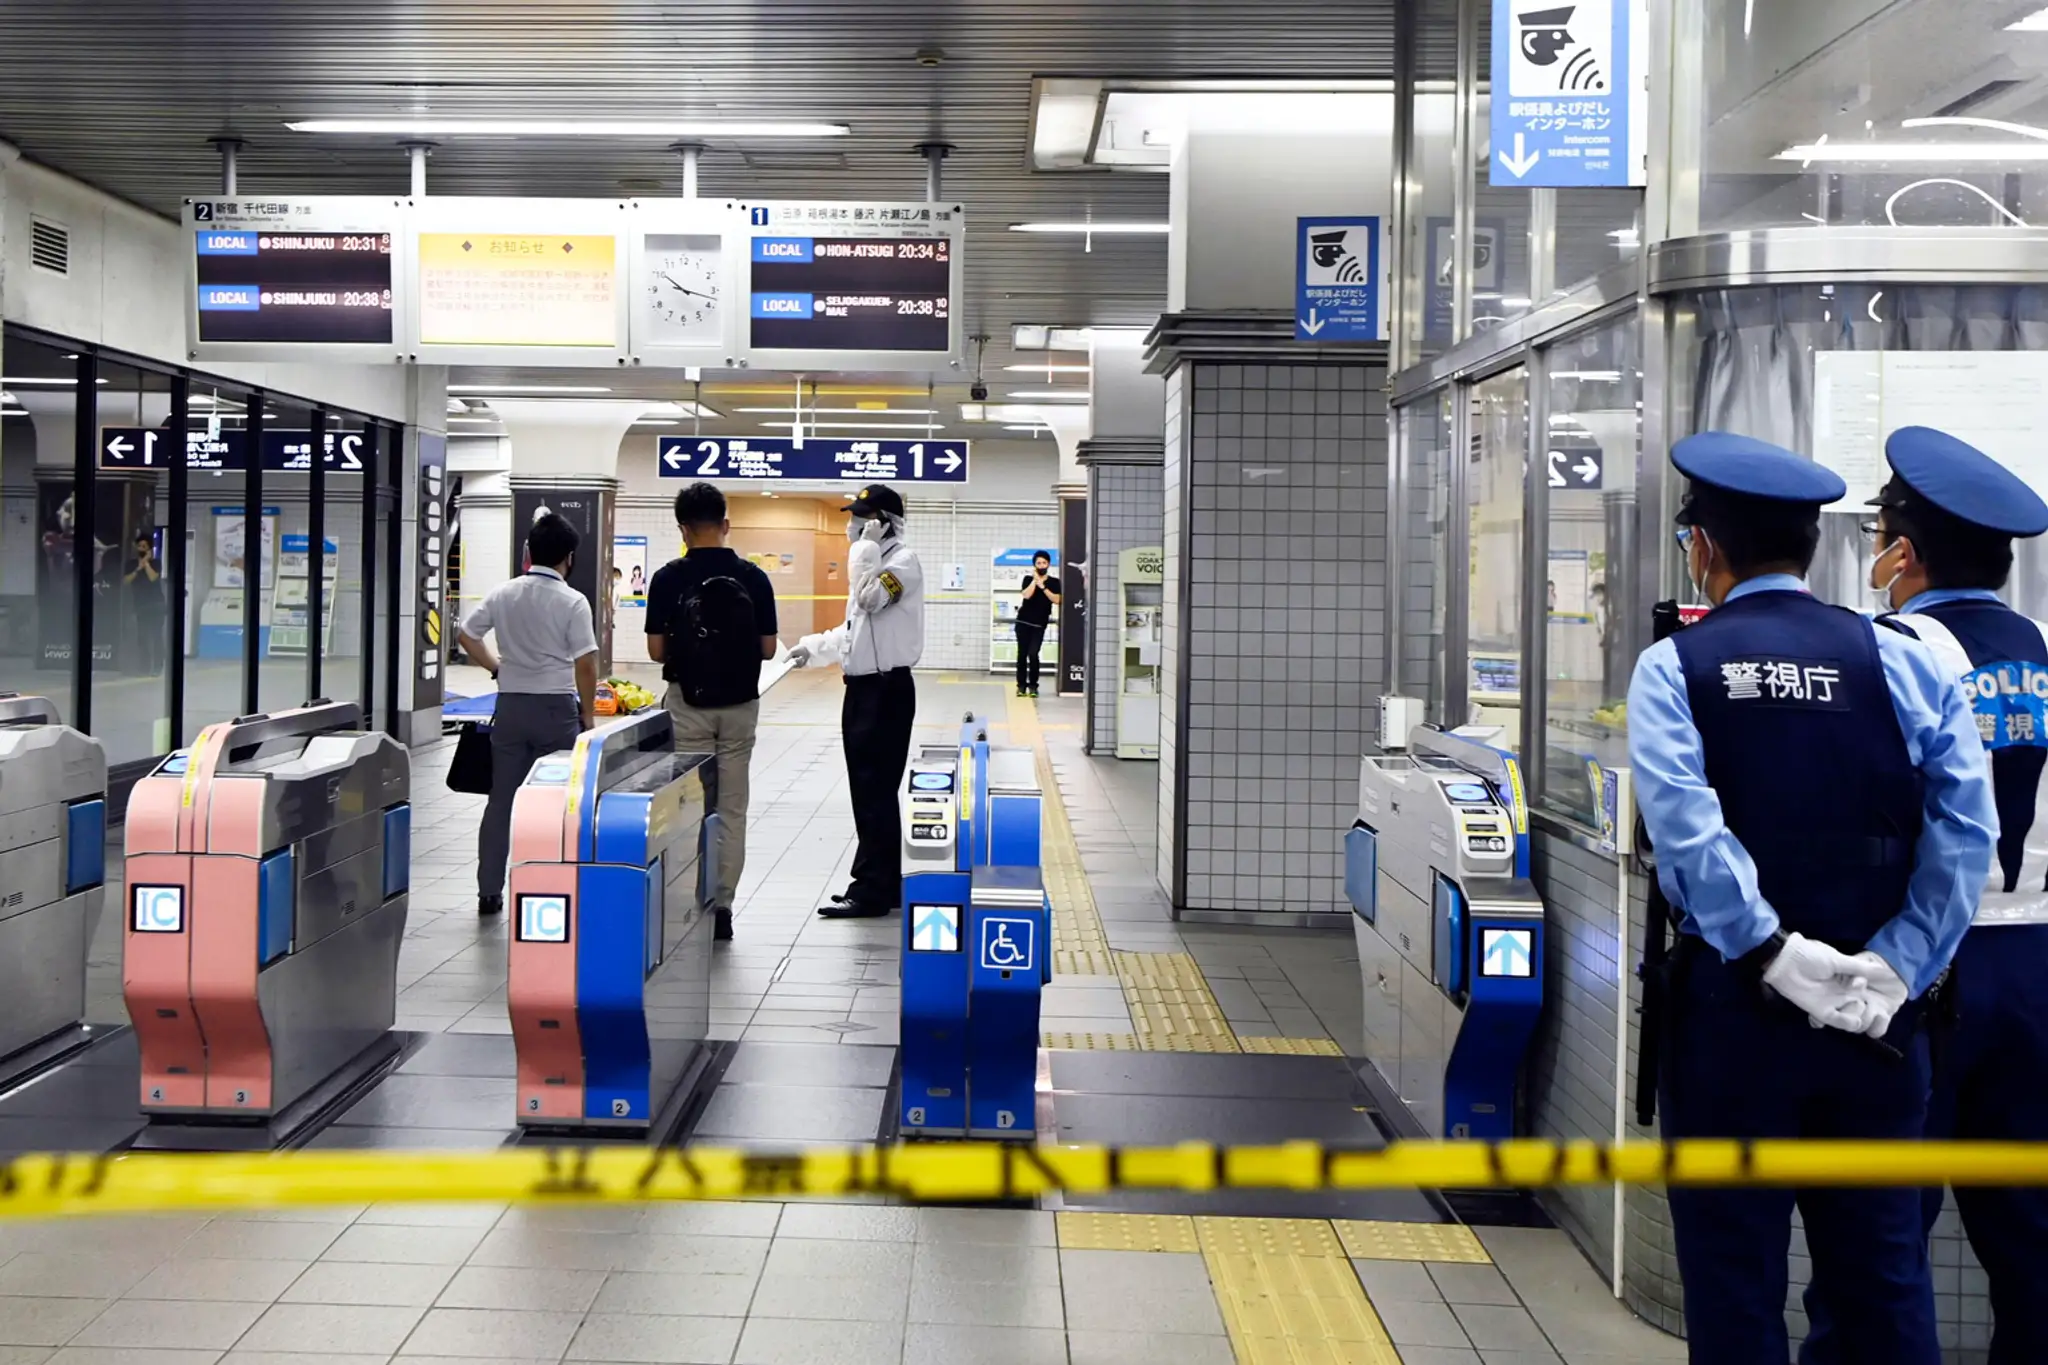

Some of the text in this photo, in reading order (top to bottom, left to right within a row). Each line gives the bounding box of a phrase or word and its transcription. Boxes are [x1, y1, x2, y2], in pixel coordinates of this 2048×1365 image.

[1525, 118, 1610, 130] インターホン
[198, 204, 209, 220] 2
[755, 209, 763, 224] 1
[208, 235, 390, 250] LOCAL SHINJUKU 20:31 8
[489, 240, 544, 254] お知らせ
[762, 242, 946, 259] LOCAL HON-ATSUGI 20:34 8
[664, 261, 675, 269] 11
[679, 257, 689, 266] 12
[695, 261, 700, 270] 1
[656, 271, 667, 279] 10
[706, 271, 711, 280] 2
[652, 286, 658, 294] 9
[711, 286, 716, 295] 3
[210, 289, 391, 306] LOCAL SHINJUKU 20:38 8
[656, 300, 663, 309] 8
[705, 301, 711, 309] 4
[762, 300, 802, 312] LOCAL
[897, 300, 933, 315] 20:38
[936, 298, 947, 308] 10
[1315, 299, 1367, 307] インターホン
[668, 310, 674, 318] 7
[695, 310, 702, 319] 5
[826, 307, 848, 317] MAE
[681, 315, 687, 323] 6
[697, 441, 720, 475] 2
[908, 443, 923, 478] 1
[1720, 661, 1840, 702] 警視庁
[140, 891, 178, 927] IC
[525, 902, 564, 936] IC
[152, 1089, 161, 1099] 4
[237, 1092, 244, 1102] 3
[530, 1099, 538, 1110] 3
[615, 1103, 624, 1114] 2
[913, 1110, 922, 1121] 2
[1001, 1114, 1007, 1125] 1
[1458, 1127, 1464, 1137] 1
